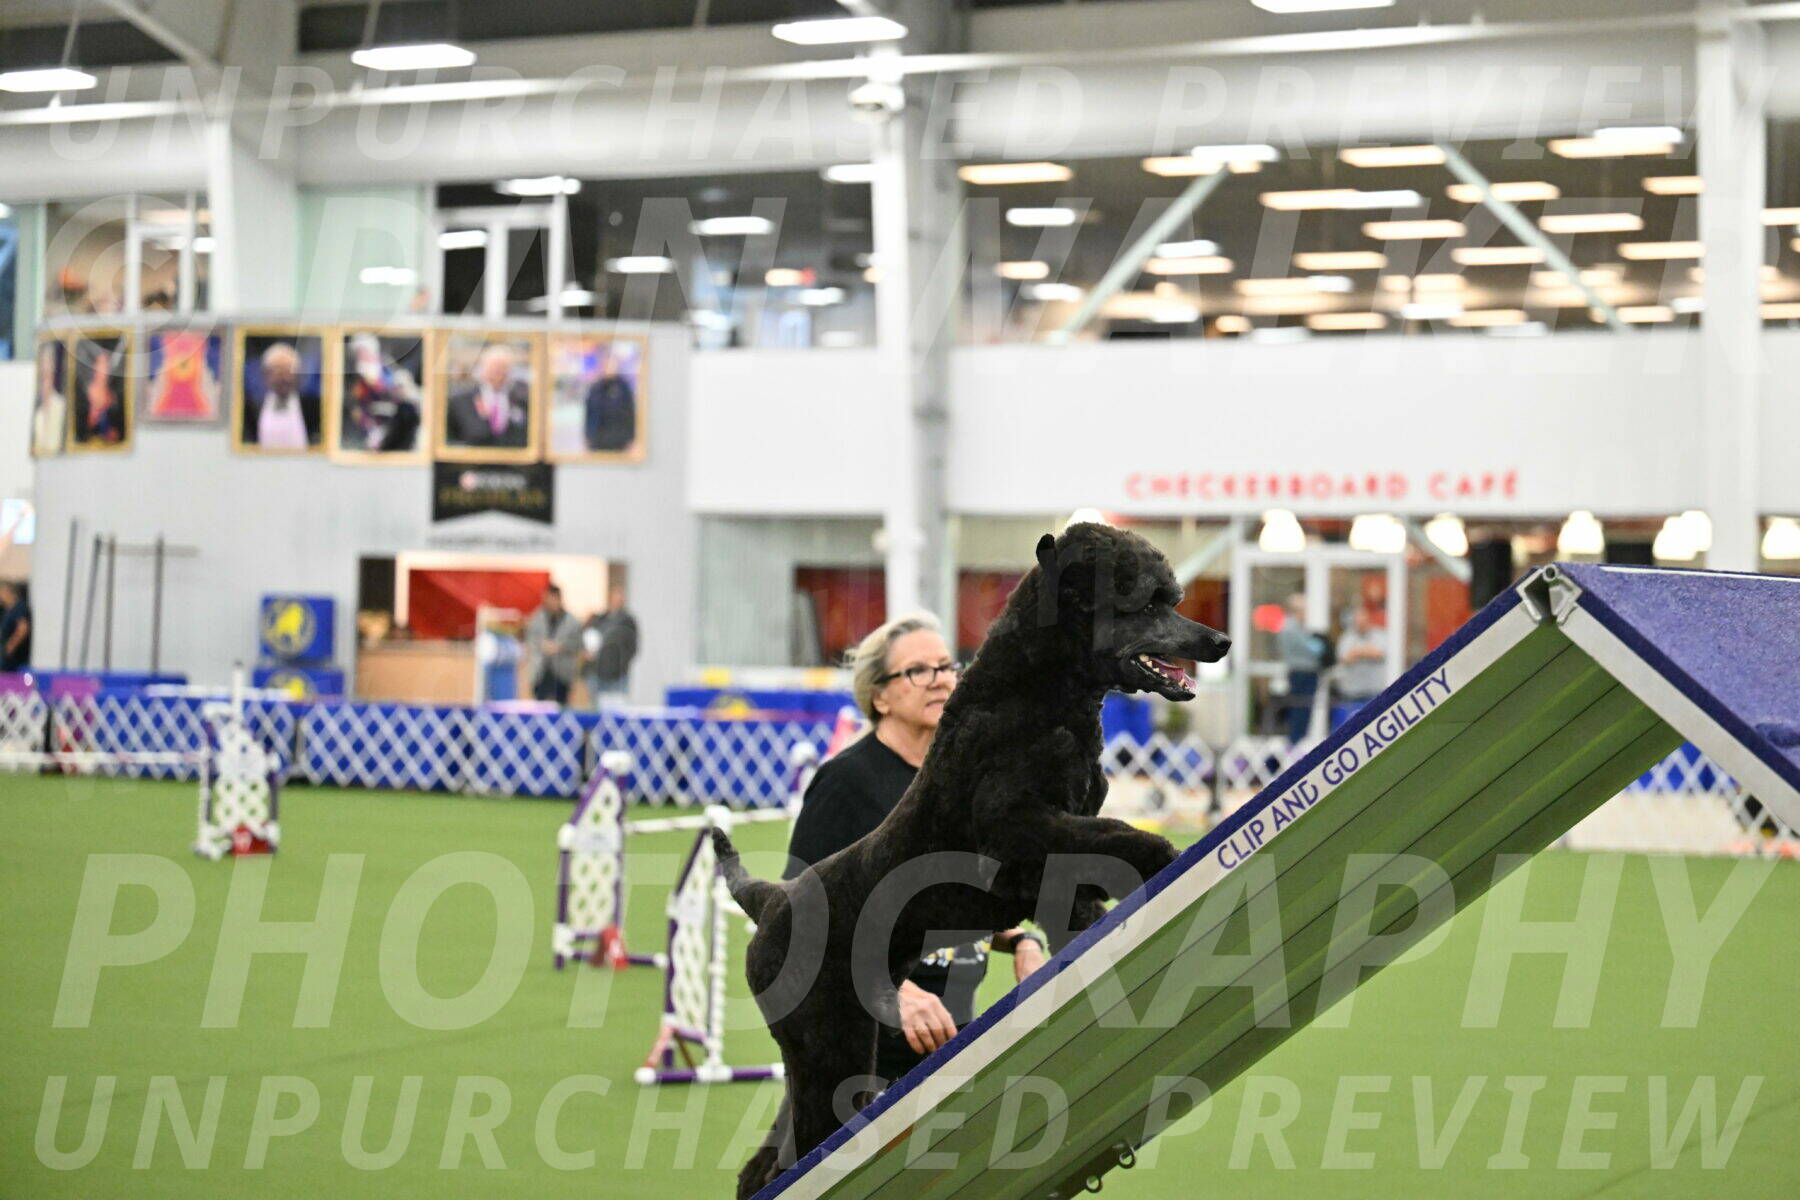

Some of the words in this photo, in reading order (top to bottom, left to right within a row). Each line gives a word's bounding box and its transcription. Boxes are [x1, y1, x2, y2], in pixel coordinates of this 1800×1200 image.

[1125, 472, 1409, 499] CHECKERBOARD
[1428, 468, 1520, 499] CAFÉ
[1217, 820, 1264, 870] CLIP
[1271, 783, 1319, 832] AND
[1322, 747, 1359, 786] GO
[1363, 667, 1452, 758] AGILITY
